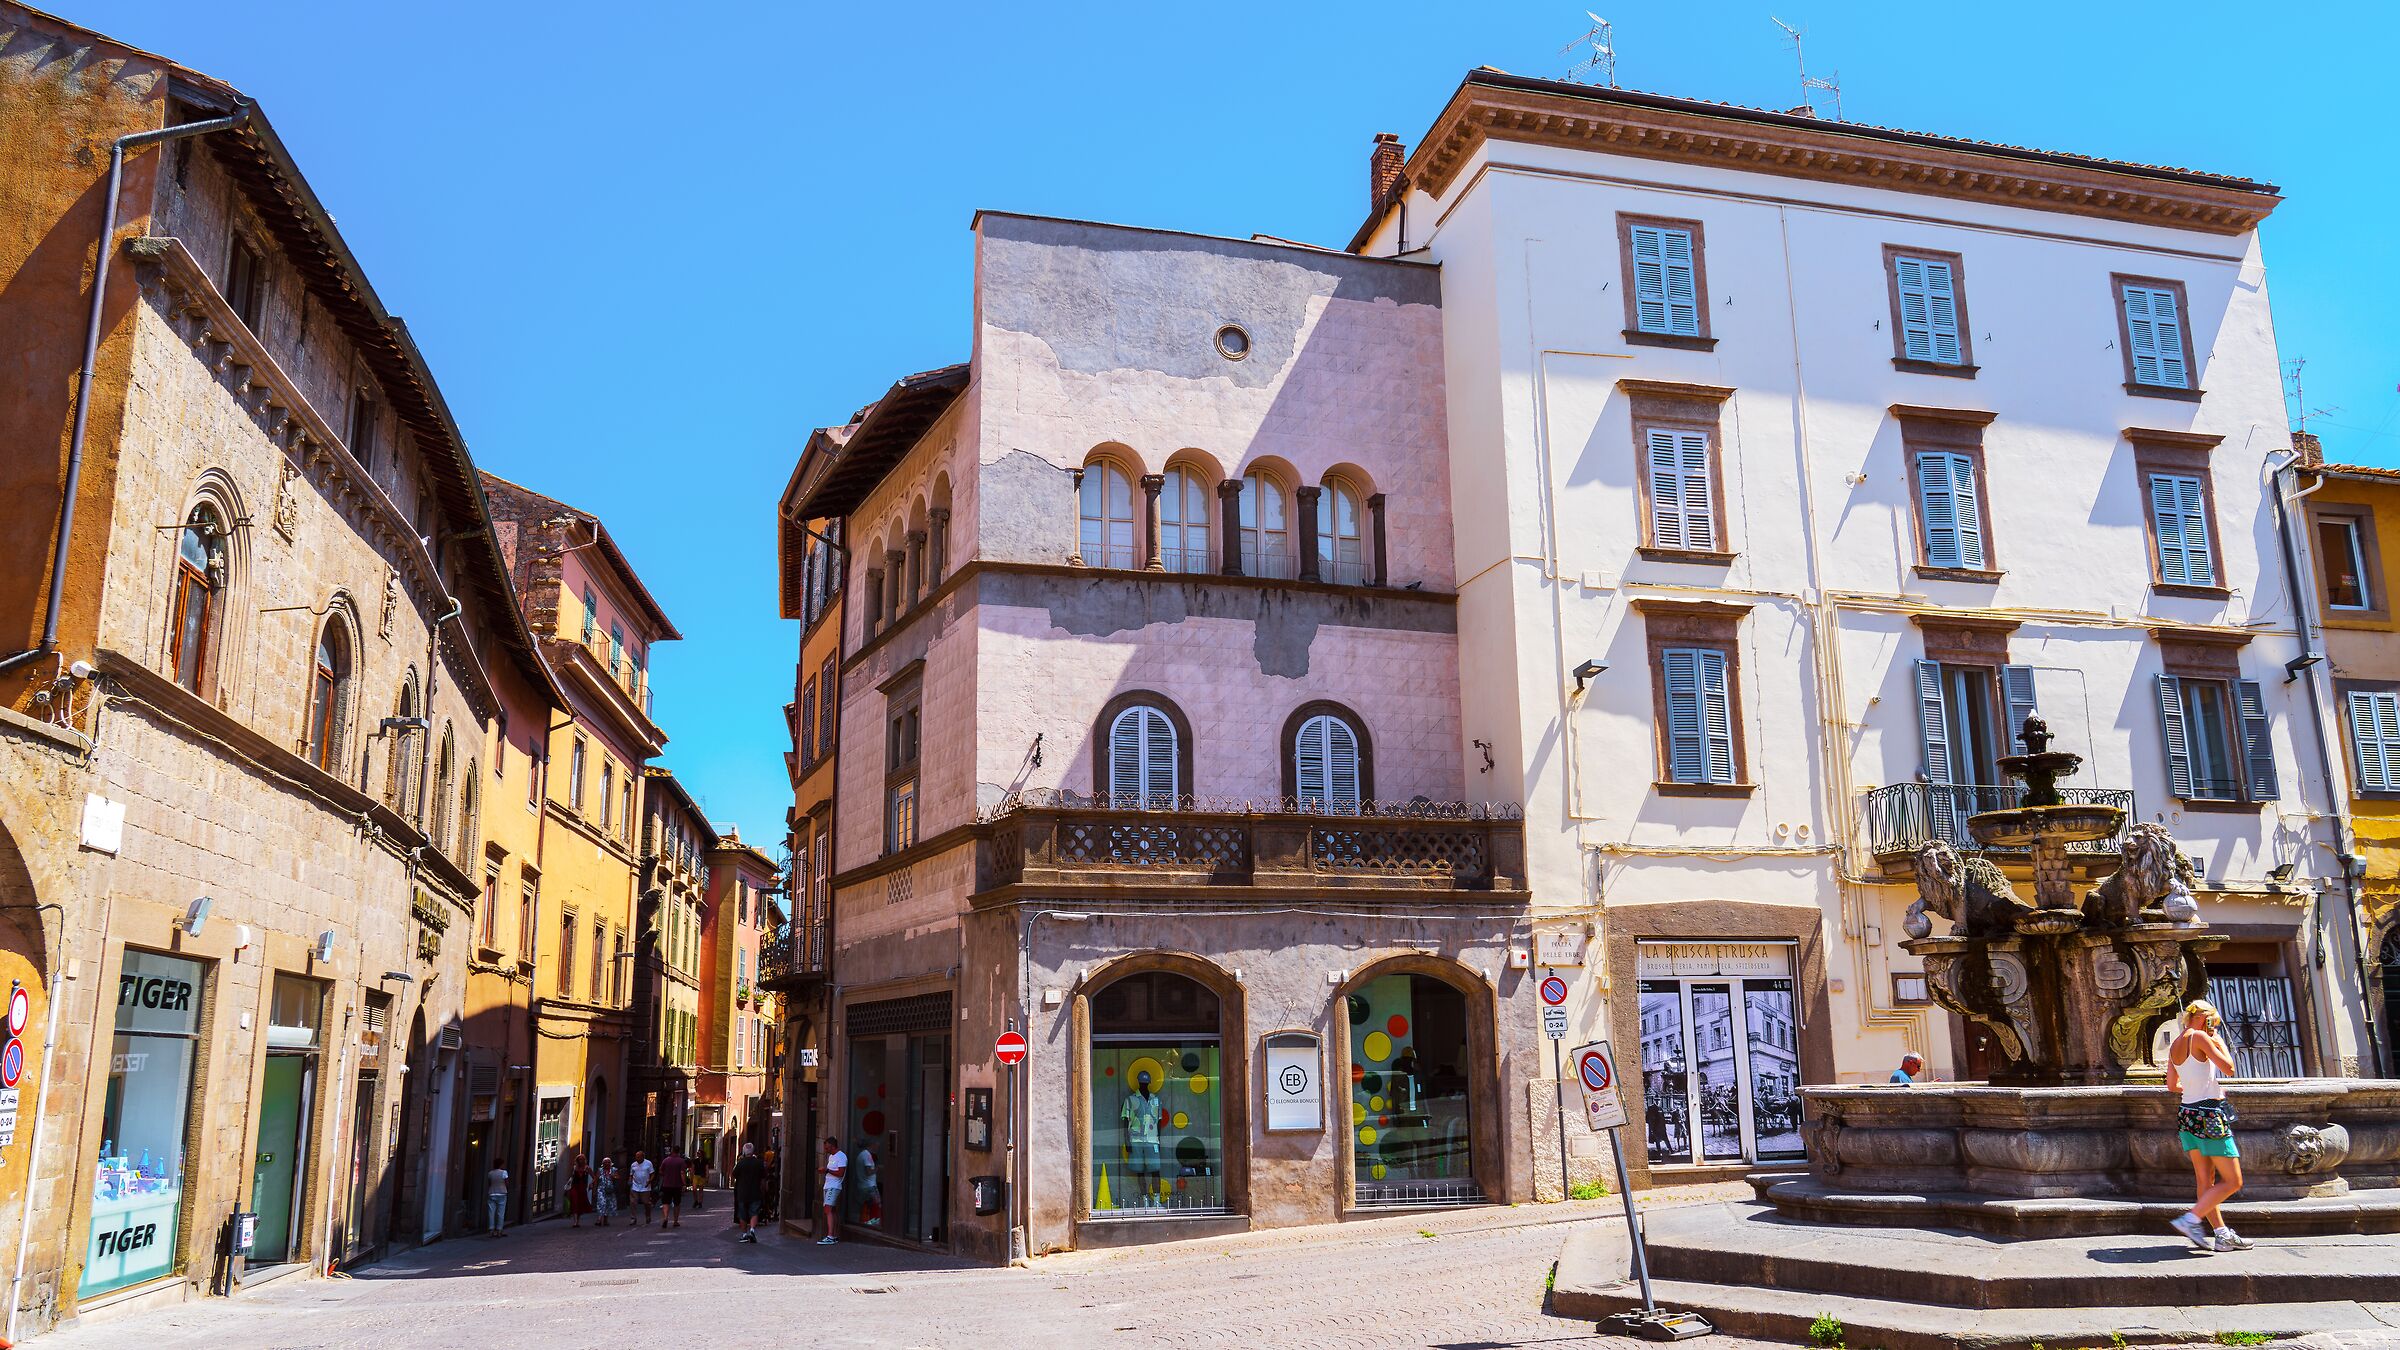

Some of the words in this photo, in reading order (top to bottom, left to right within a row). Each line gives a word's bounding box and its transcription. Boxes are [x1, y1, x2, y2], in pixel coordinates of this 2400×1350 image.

[1645, 945, 1659, 958] LA
[1665, 945, 1711, 958] BRUSCA
[1717, 945, 1768, 958] ETRUSCA
[118, 974, 192, 1011] TIGER
[1286, 1073, 1301, 1087] EB
[98, 1223, 157, 1258] TIGER
